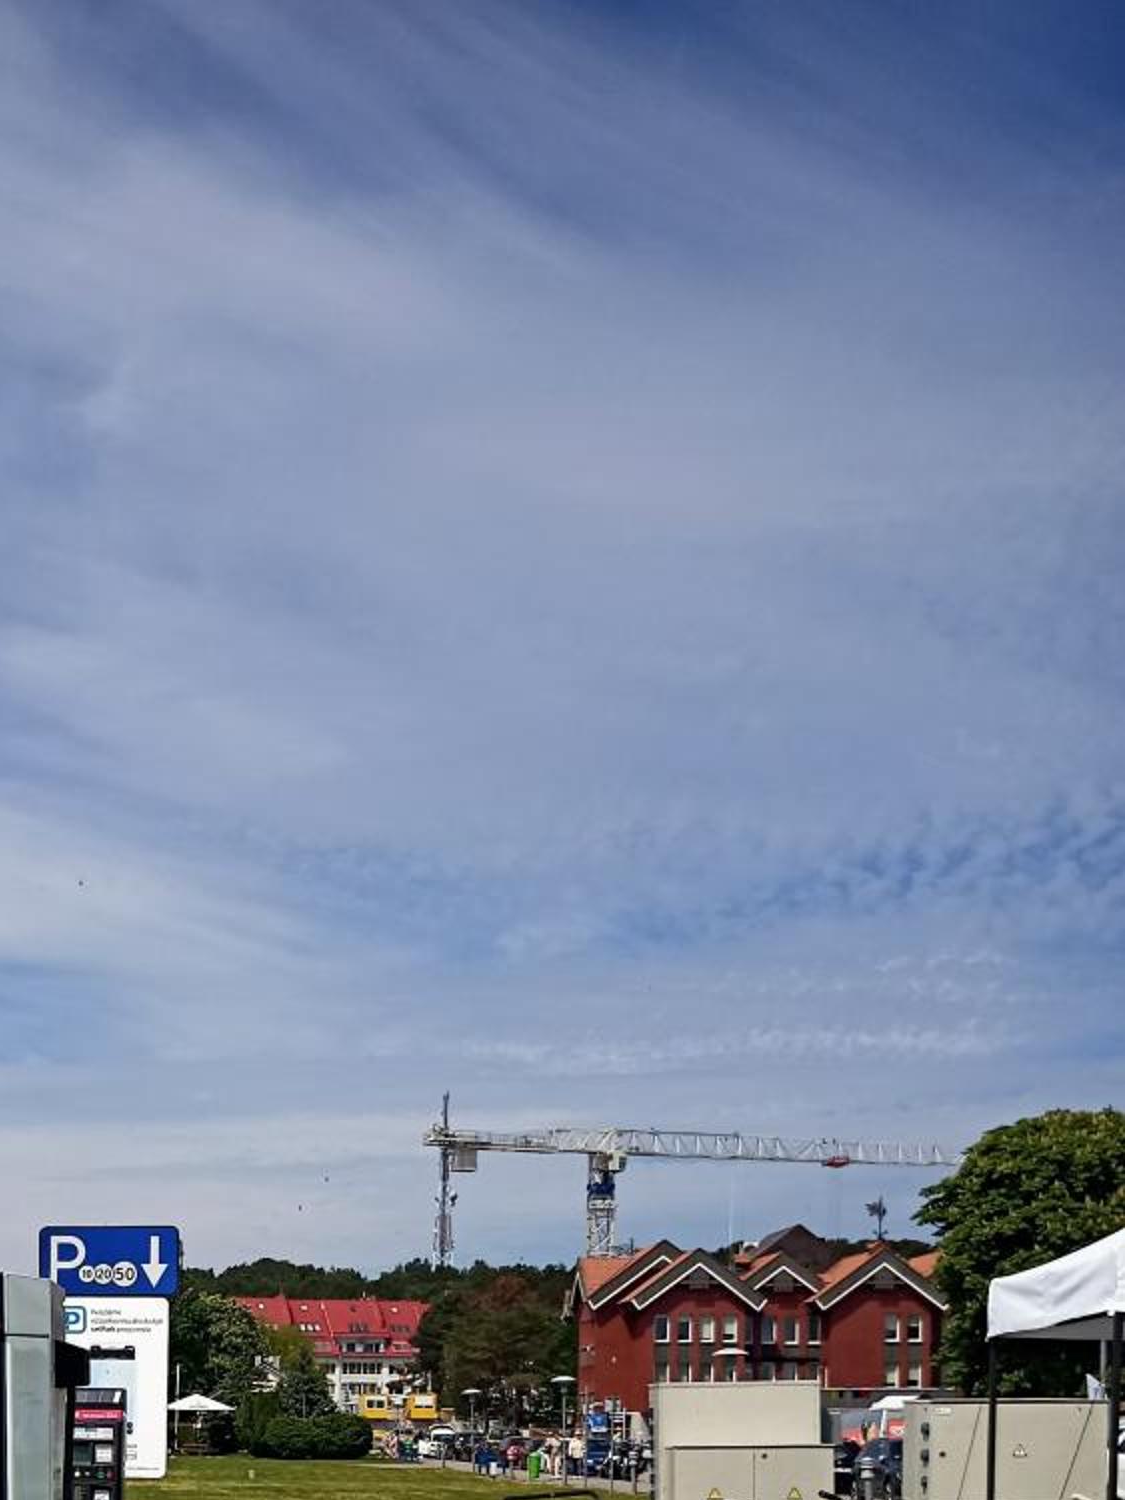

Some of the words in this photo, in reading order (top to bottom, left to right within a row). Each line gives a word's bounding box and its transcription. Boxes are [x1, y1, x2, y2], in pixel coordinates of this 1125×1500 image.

[50, 1235, 86, 1285] P
[95, 1267, 111, 1279] 20
[116, 1267, 135, 1281] 50
[63, 1311, 80, 1330] P
